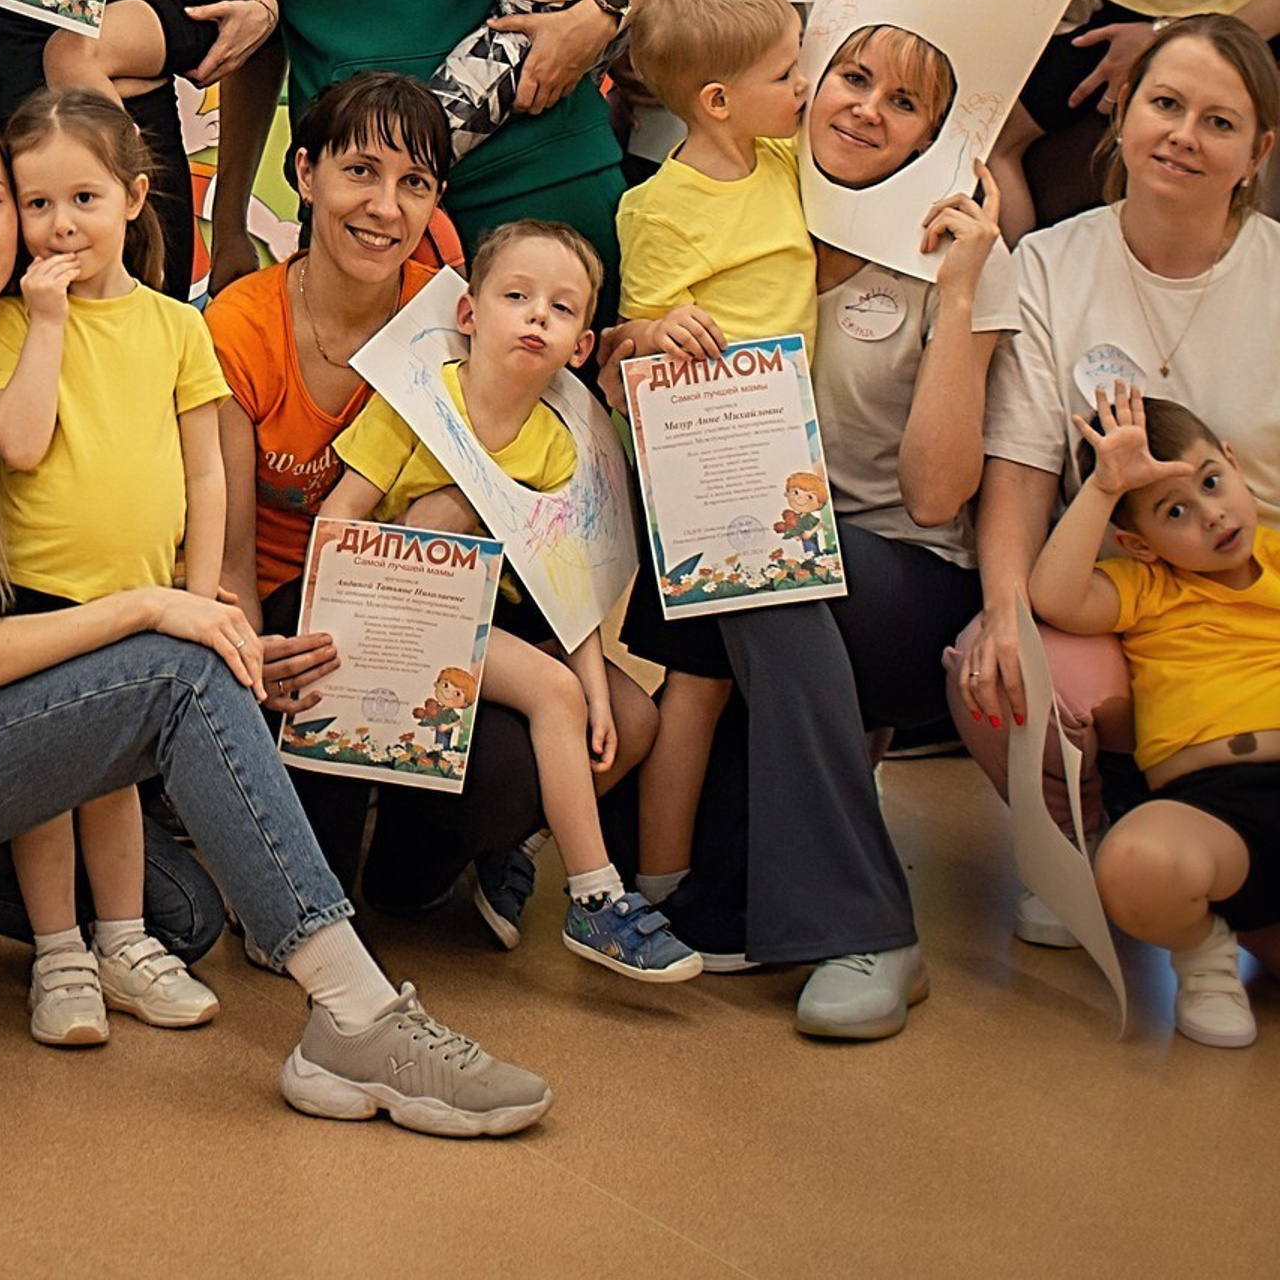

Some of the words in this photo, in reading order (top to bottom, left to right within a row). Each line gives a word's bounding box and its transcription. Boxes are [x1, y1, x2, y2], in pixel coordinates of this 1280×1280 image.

[649, 347, 783, 391] ДИПЛОМ
[670, 393, 701, 404] Самой
[704, 386, 739, 400] лучшей
[741, 383, 768, 393] мамы
[664, 419, 693, 433] Мазур
[723, 406, 784, 422] Михайловне
[336, 527, 478, 570] ДИПЛОМ
[353, 556, 386, 569] Самой
[387, 561, 425, 574] лучшей
[427, 567, 455, 578] мамы
